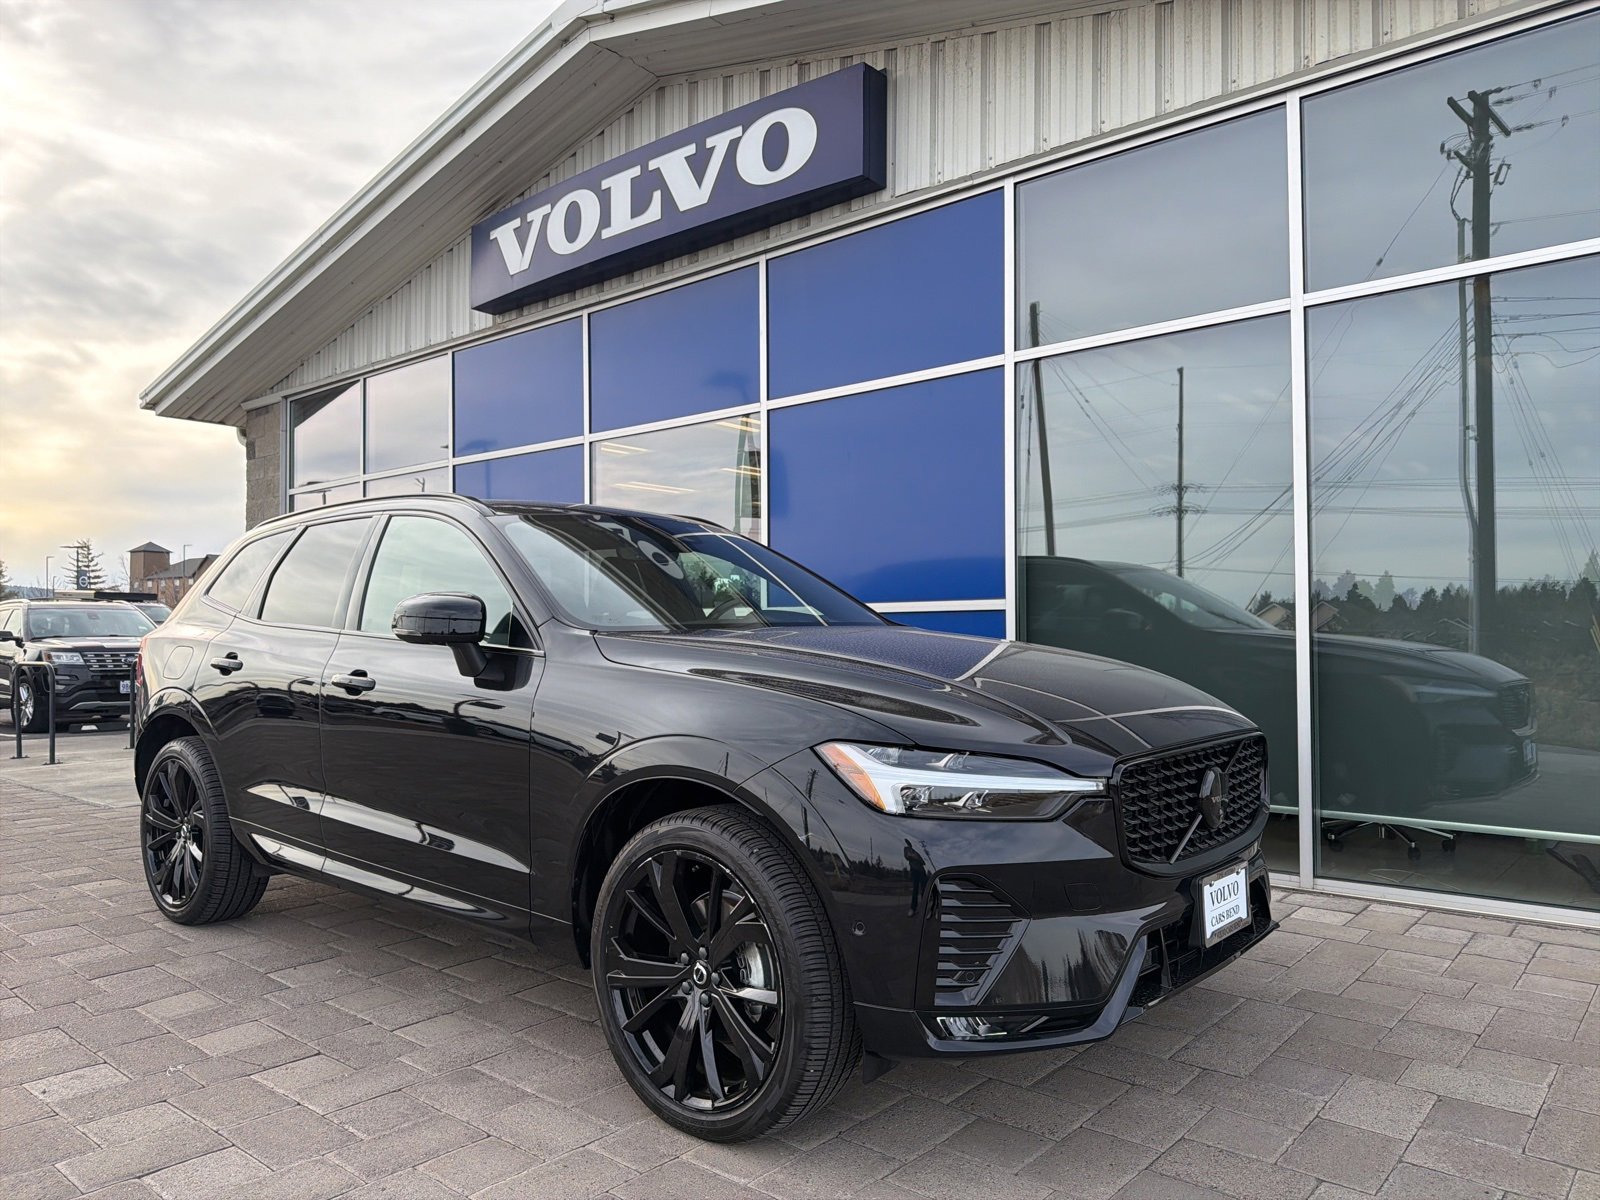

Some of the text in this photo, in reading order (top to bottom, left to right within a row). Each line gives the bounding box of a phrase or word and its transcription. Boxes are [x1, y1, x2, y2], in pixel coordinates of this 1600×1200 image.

[489, 107, 818, 277] VOLVO
[1209, 880, 1239, 907] VOLVO
[1210, 904, 1240, 927] CARS BEND
